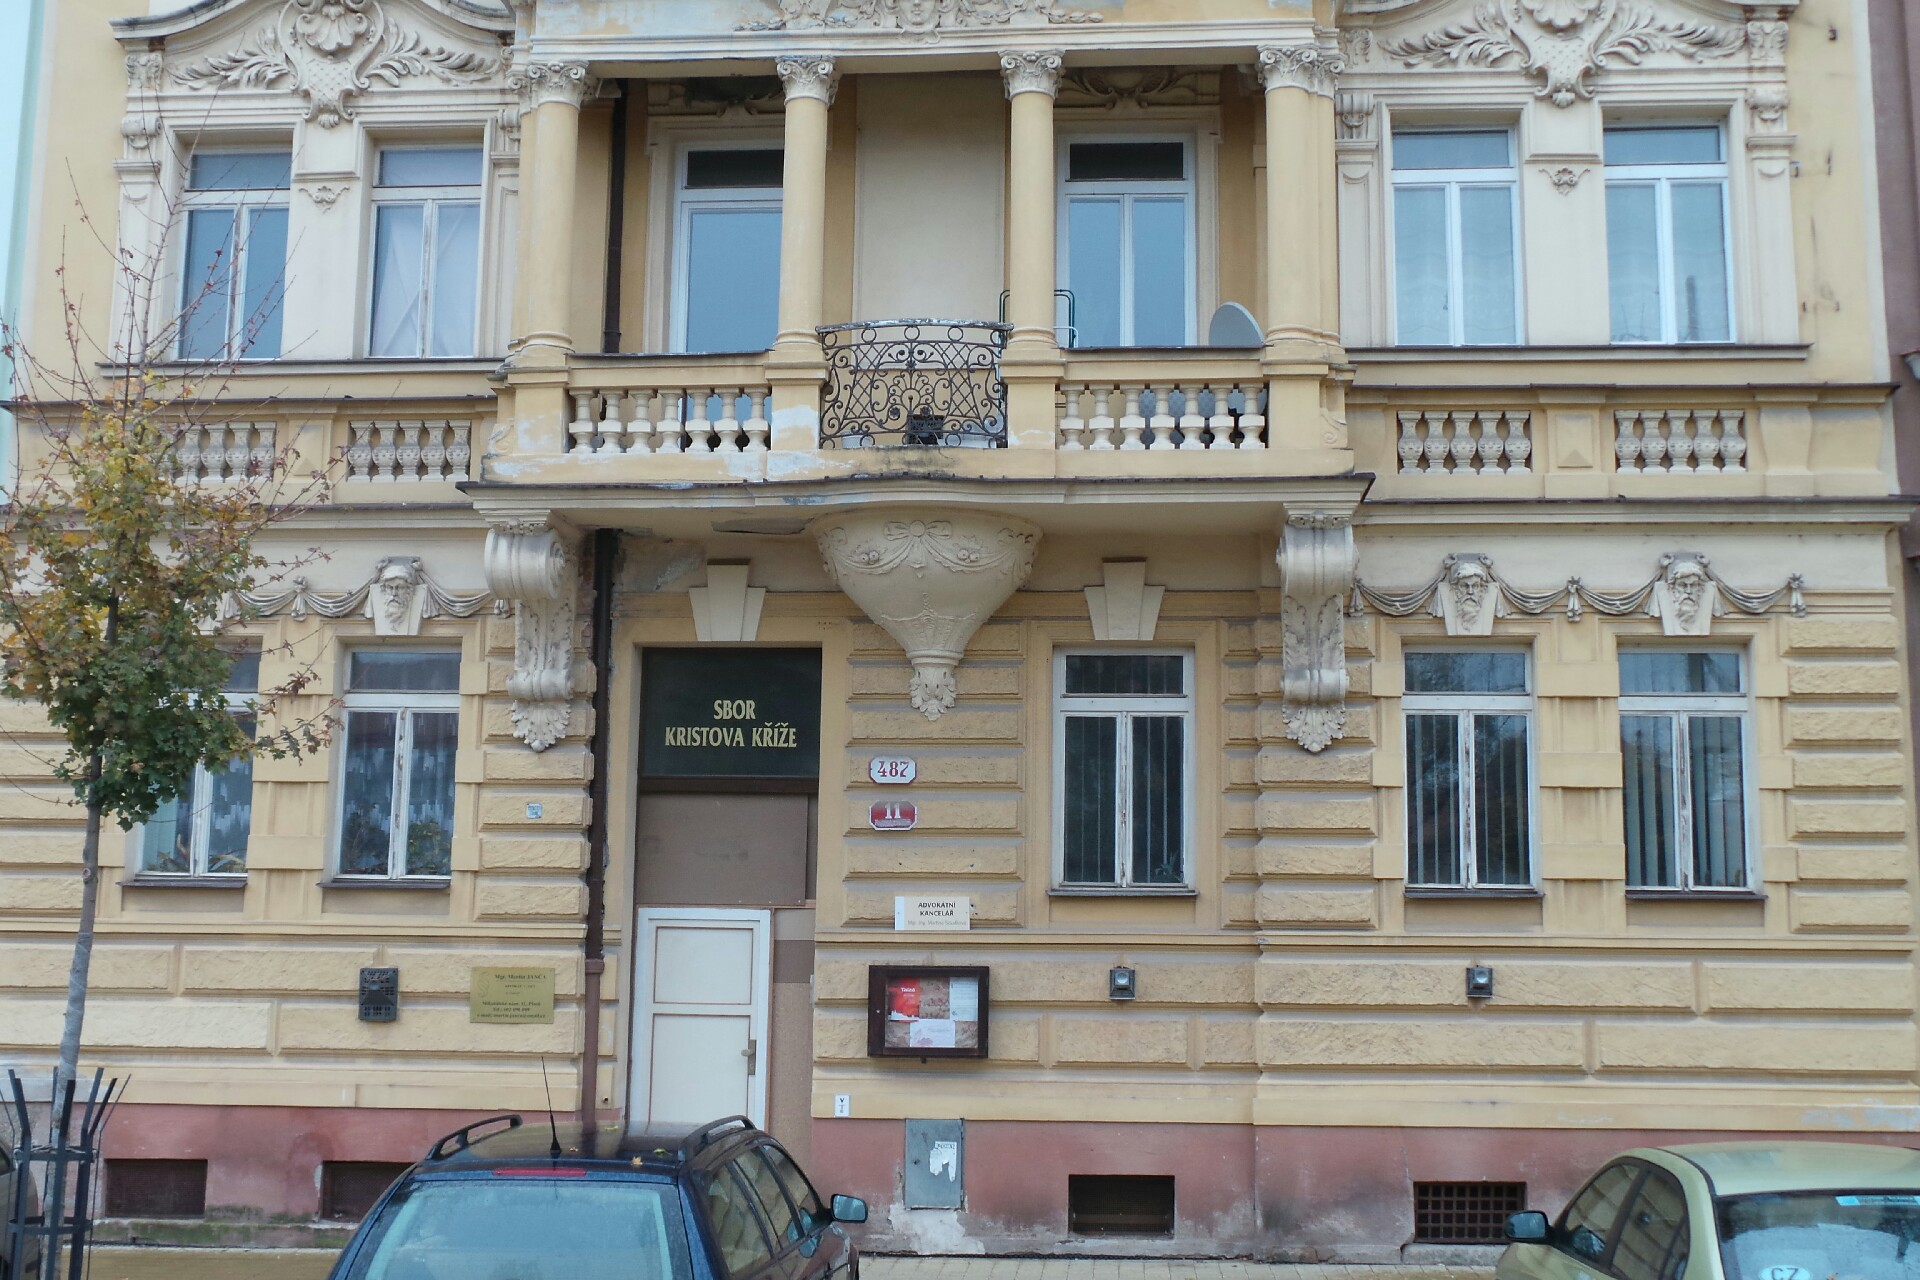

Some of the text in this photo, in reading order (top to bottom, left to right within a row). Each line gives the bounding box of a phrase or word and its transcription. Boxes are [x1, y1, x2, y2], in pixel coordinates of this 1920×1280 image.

[713, 699, 756, 720] SBOR
[664, 721, 798, 748] KRISTOVA KŘÍŽE
[877, 760, 910, 778] 487
[884, 802, 901, 819] 11
[918, 900, 956, 909] ADVOKÁTNÍ
[1771, 1267, 1799, 1280] CZ
